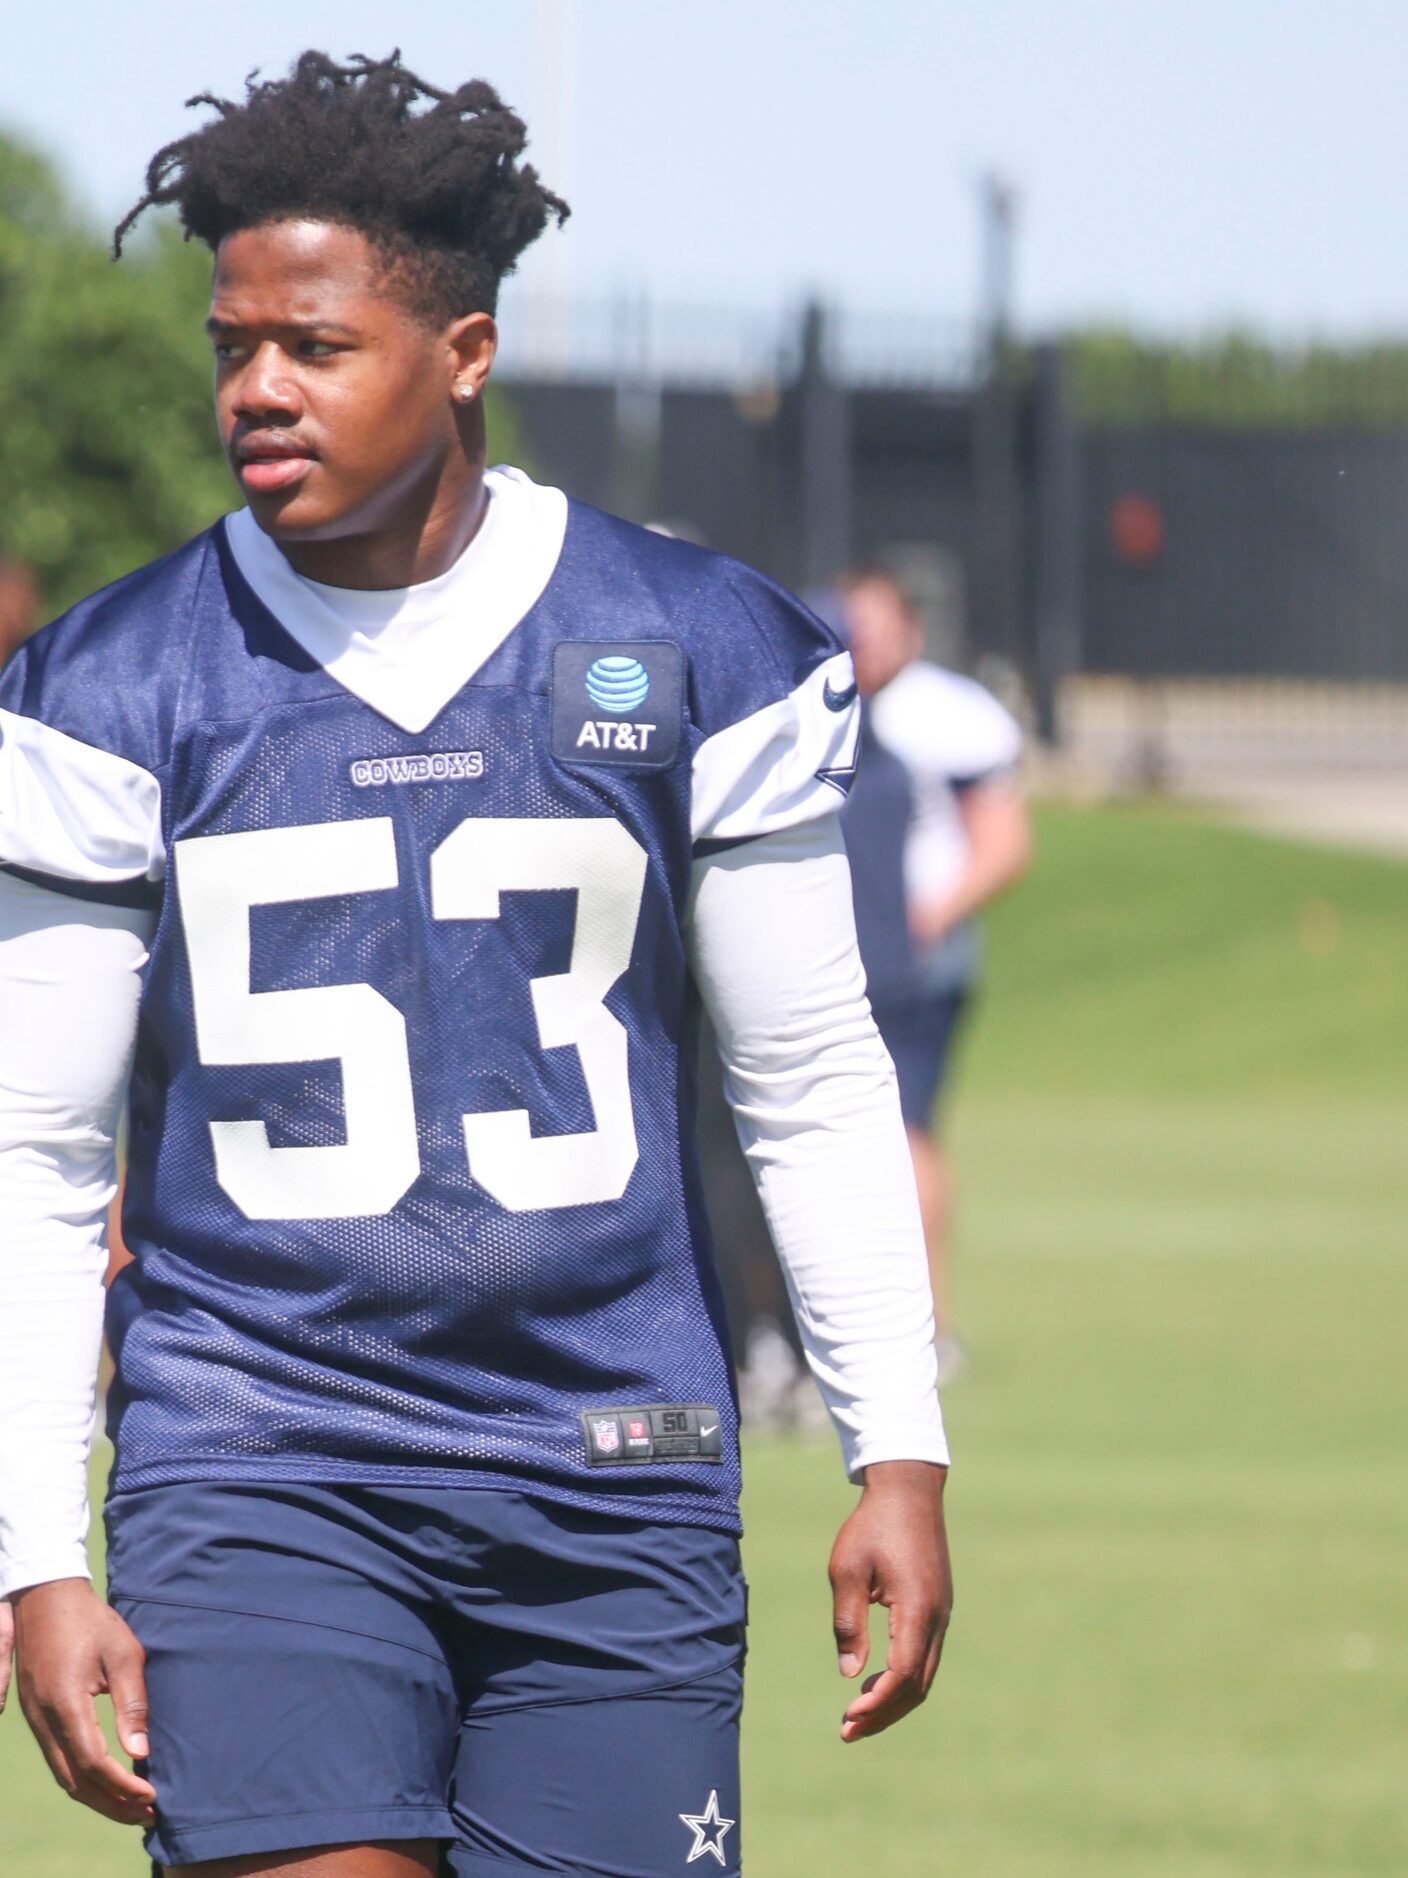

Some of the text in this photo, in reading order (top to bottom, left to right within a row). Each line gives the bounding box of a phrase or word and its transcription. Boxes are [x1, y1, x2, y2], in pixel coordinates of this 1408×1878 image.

[577, 721, 656, 751] AT&T
[351, 752, 483, 787] COWBOYS
[174, 816, 649, 1220] 53
[662, 1411, 688, 1433] 50
